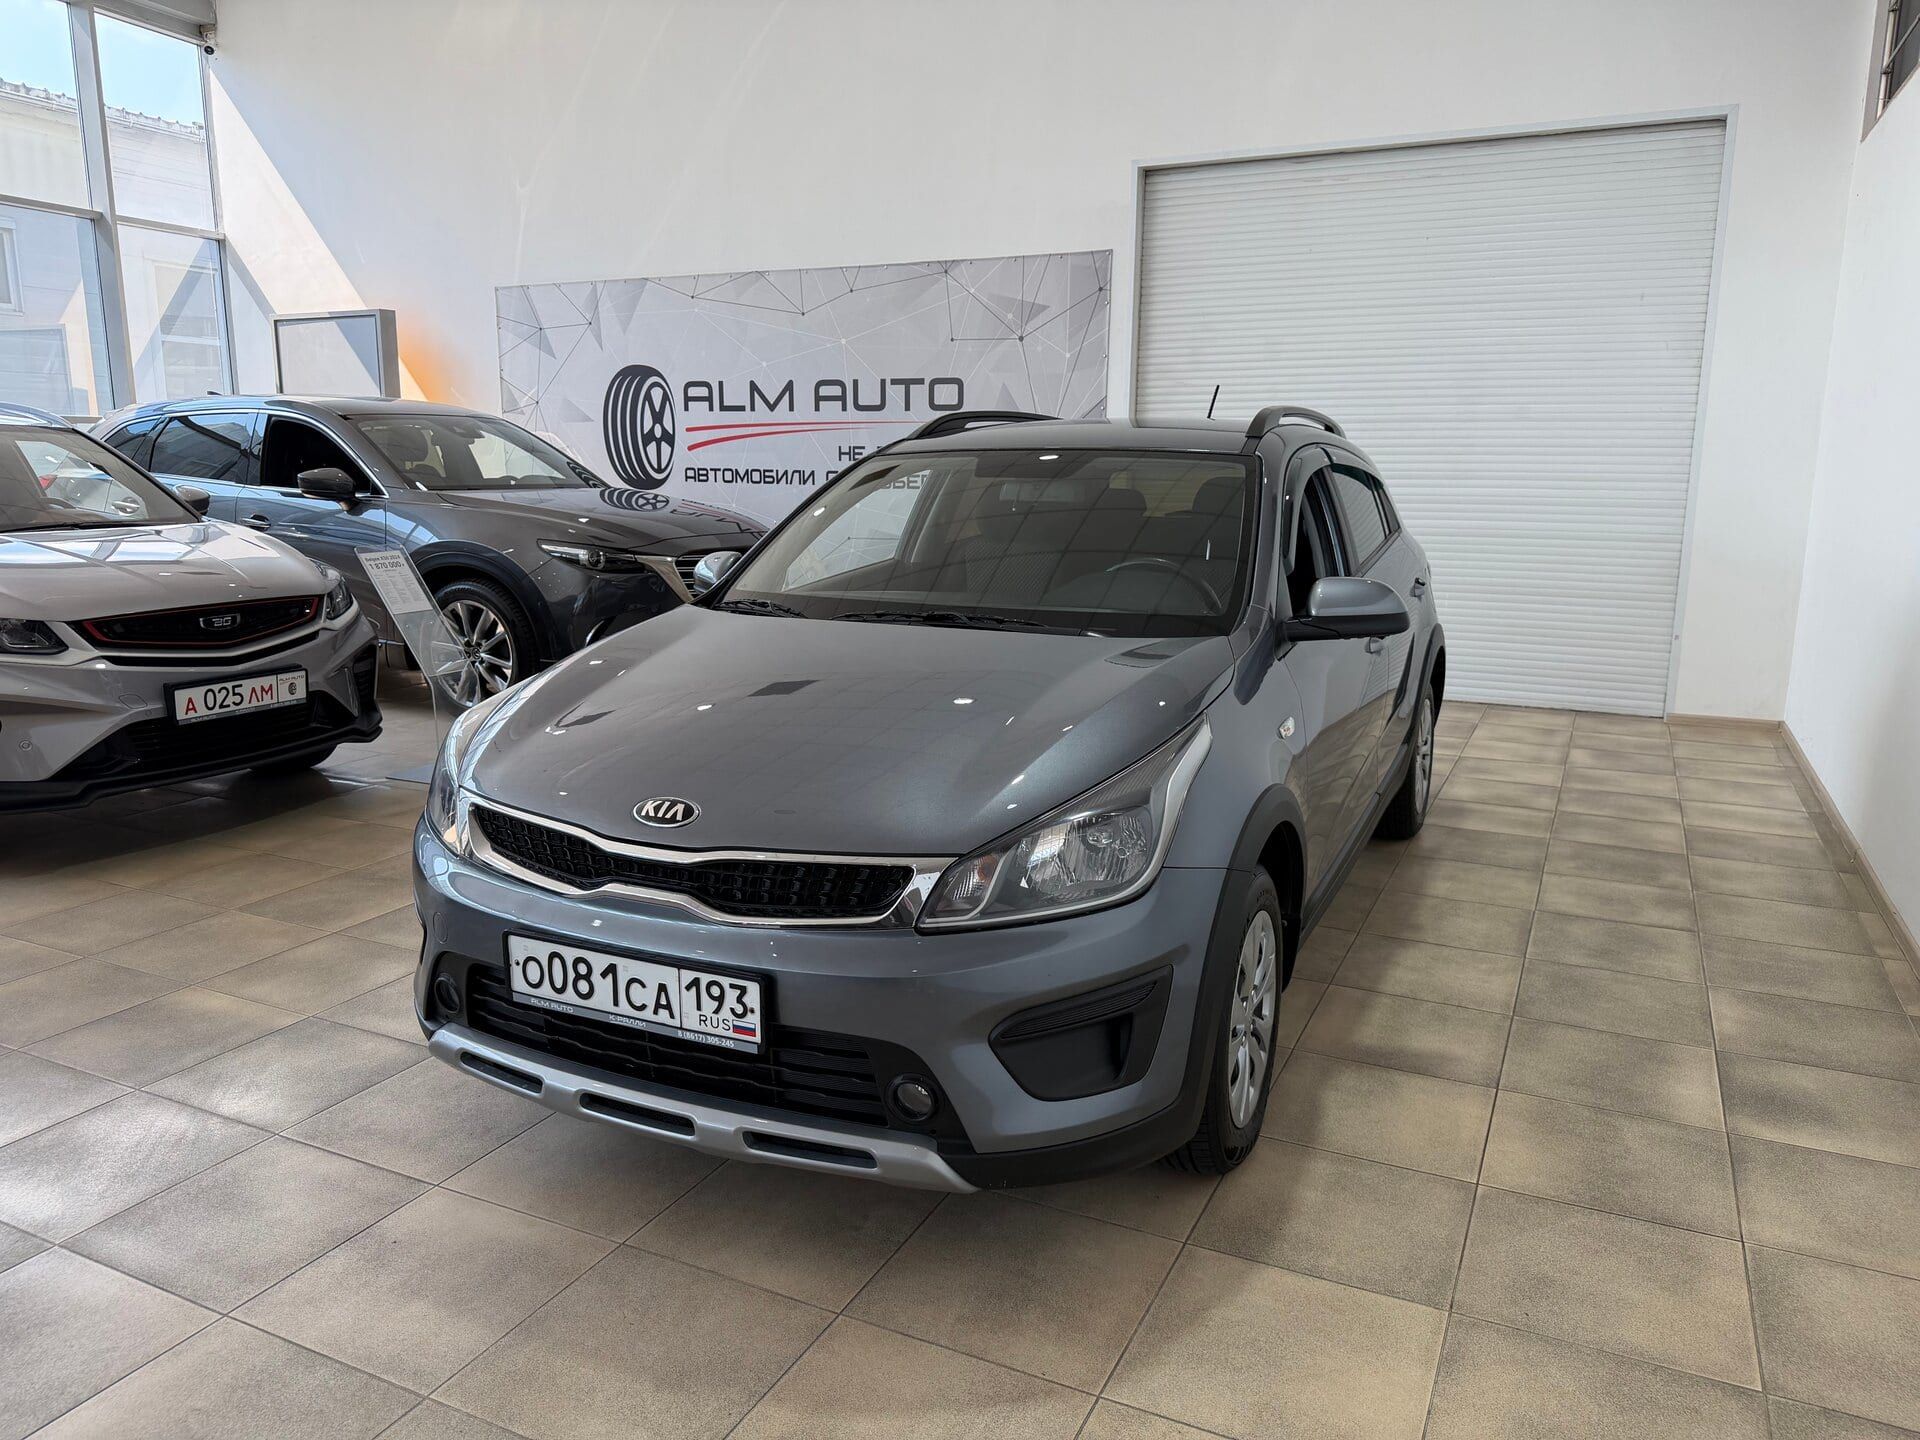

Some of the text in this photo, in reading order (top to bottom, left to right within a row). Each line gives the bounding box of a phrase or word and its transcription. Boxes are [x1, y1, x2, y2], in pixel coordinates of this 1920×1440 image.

[683, 376, 964, 412] ALM AUTO
[838, 445, 866, 461] НЕ
[684, 467, 816, 485] АВТОМОБИЛИ
[203, 683, 245, 711] 025
[640, 800, 686, 821] KIA
[684, 976, 748, 1020] 193
[698, 1014, 732, 1032] RUS
